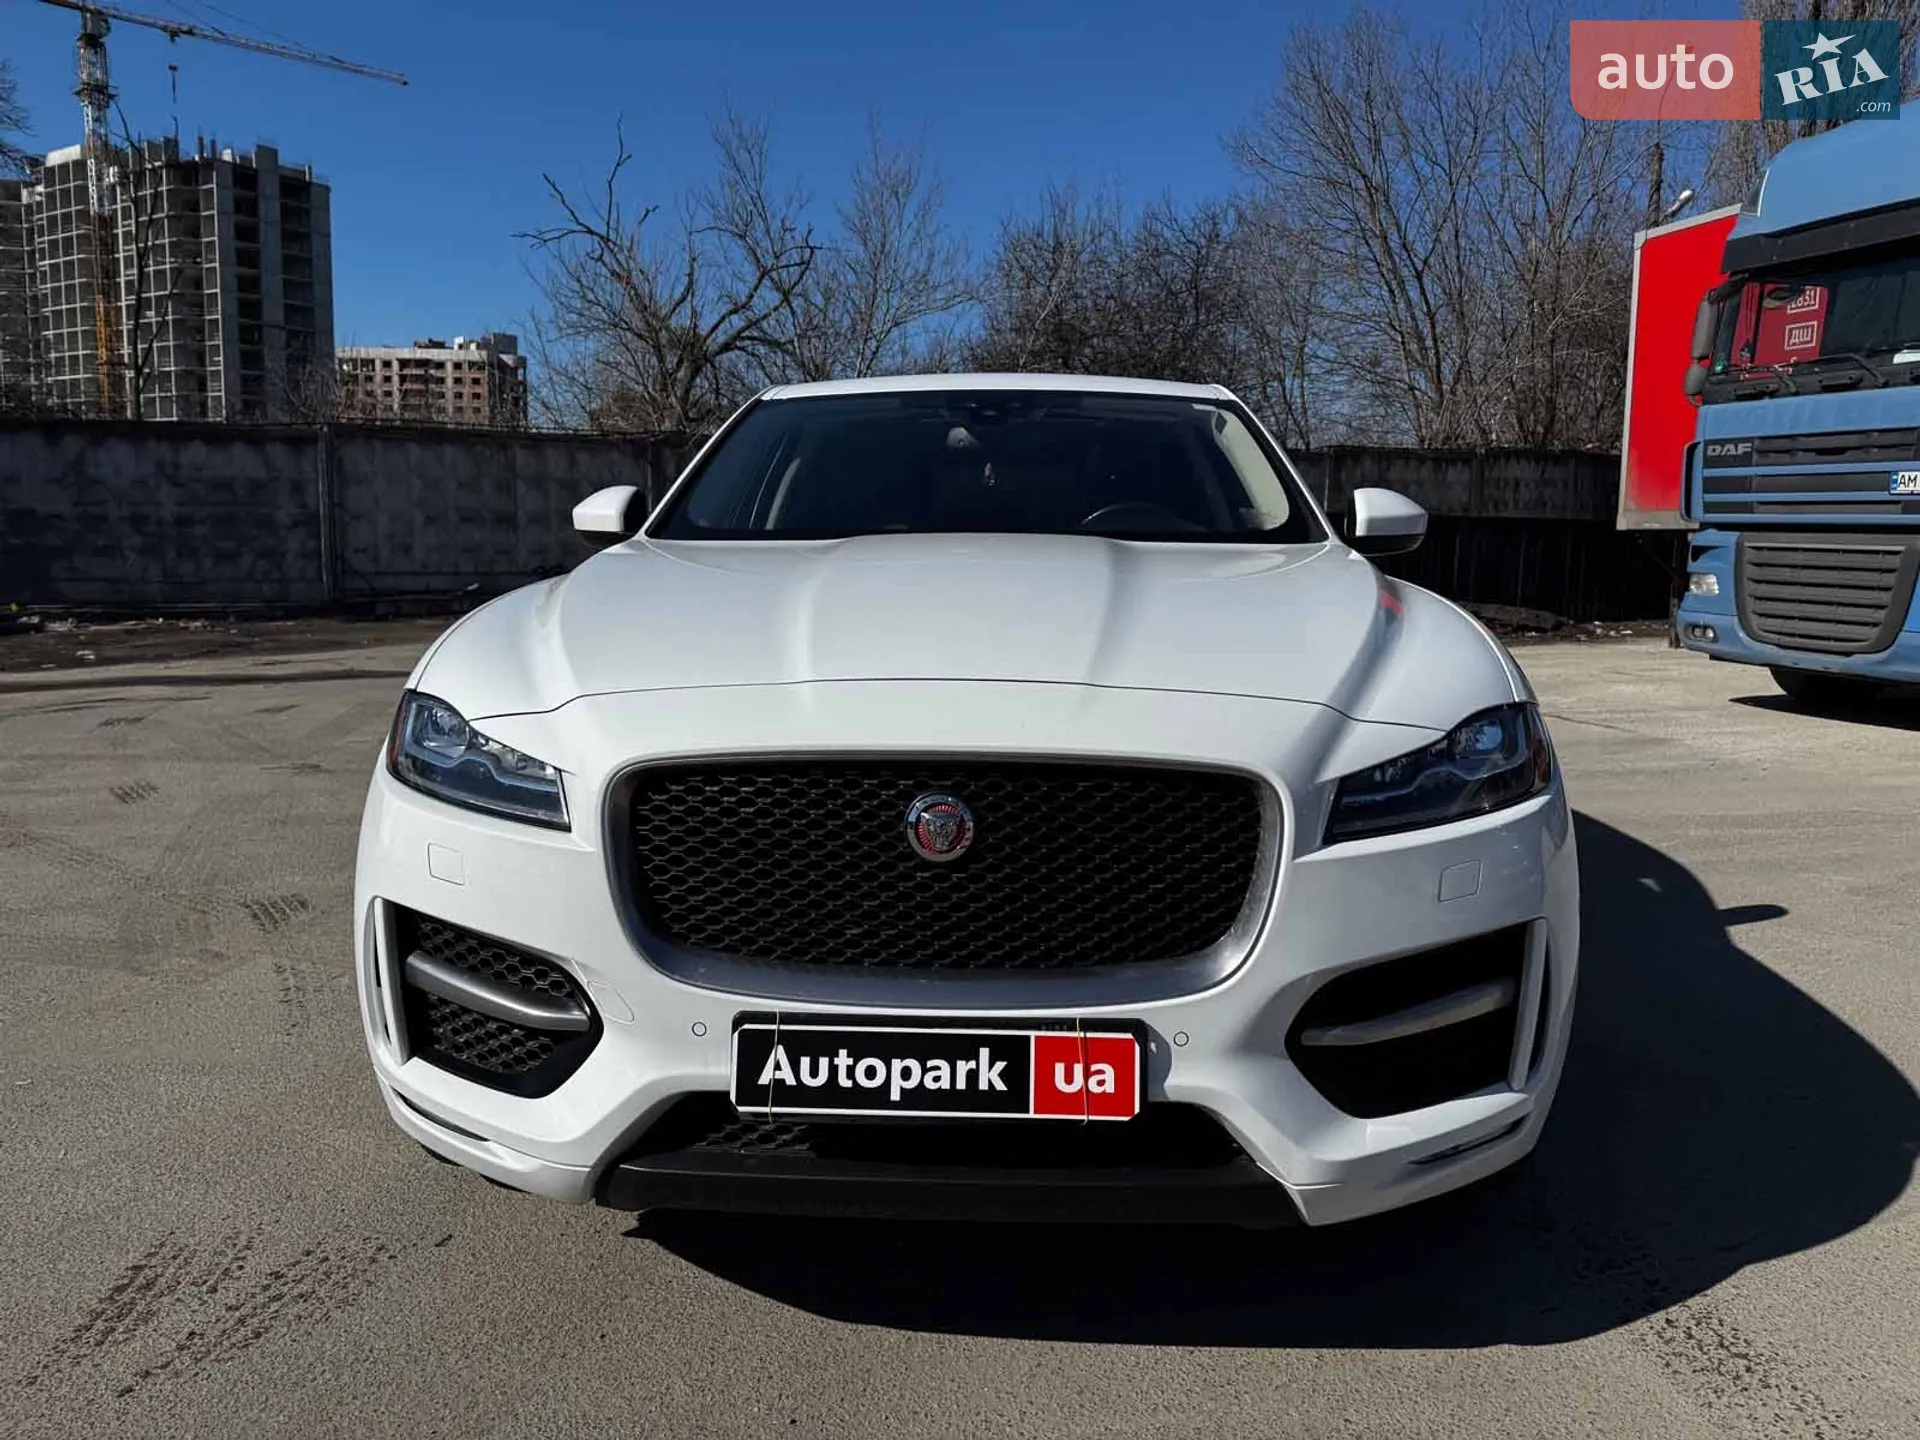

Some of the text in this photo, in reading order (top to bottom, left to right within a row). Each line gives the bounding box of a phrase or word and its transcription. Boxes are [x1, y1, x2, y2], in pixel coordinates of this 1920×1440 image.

[1707, 442, 1752, 456] DAF
[757, 1044, 1115, 1101] Autopark ua
